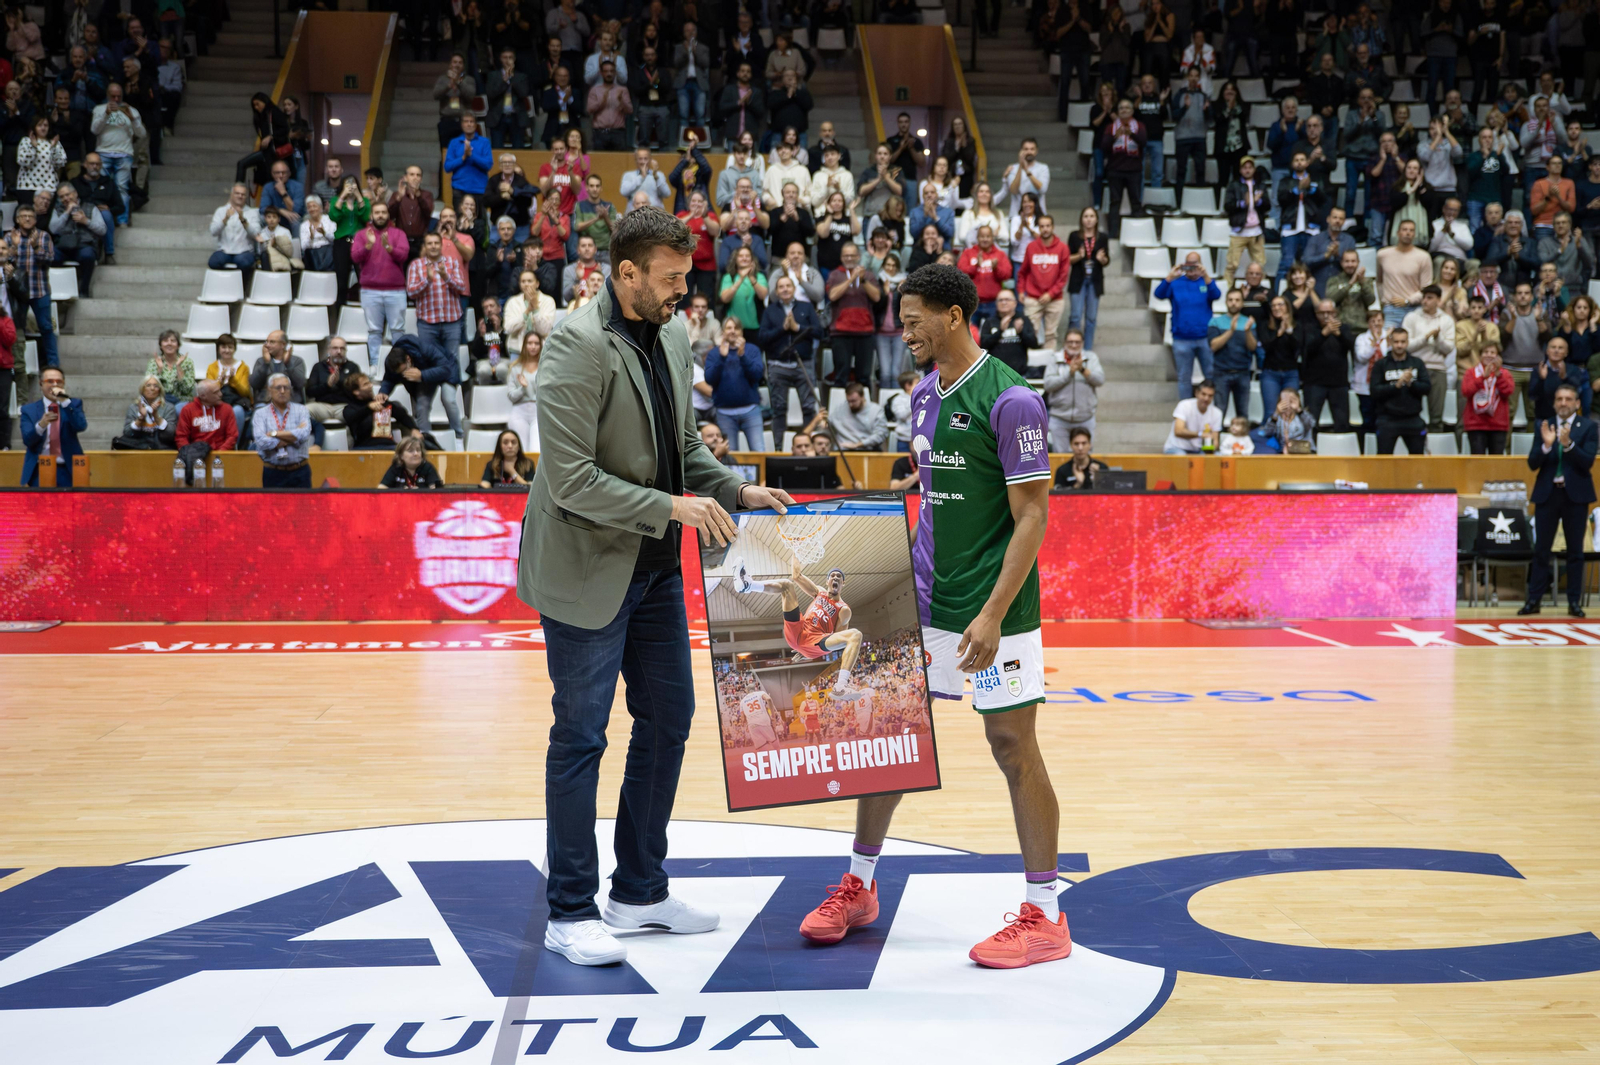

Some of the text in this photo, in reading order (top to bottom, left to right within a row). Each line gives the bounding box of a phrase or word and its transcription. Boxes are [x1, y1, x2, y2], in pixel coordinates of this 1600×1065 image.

[929, 450, 966, 467] Unicaja
[108, 639, 514, 652] Ajuntament
[1044, 688, 1378, 703] desa
[746, 700, 761, 713] 35
[742, 727, 920, 782] SEMPRE GIRONÍ!
[216, 1013, 820, 1064] MÚTUA
